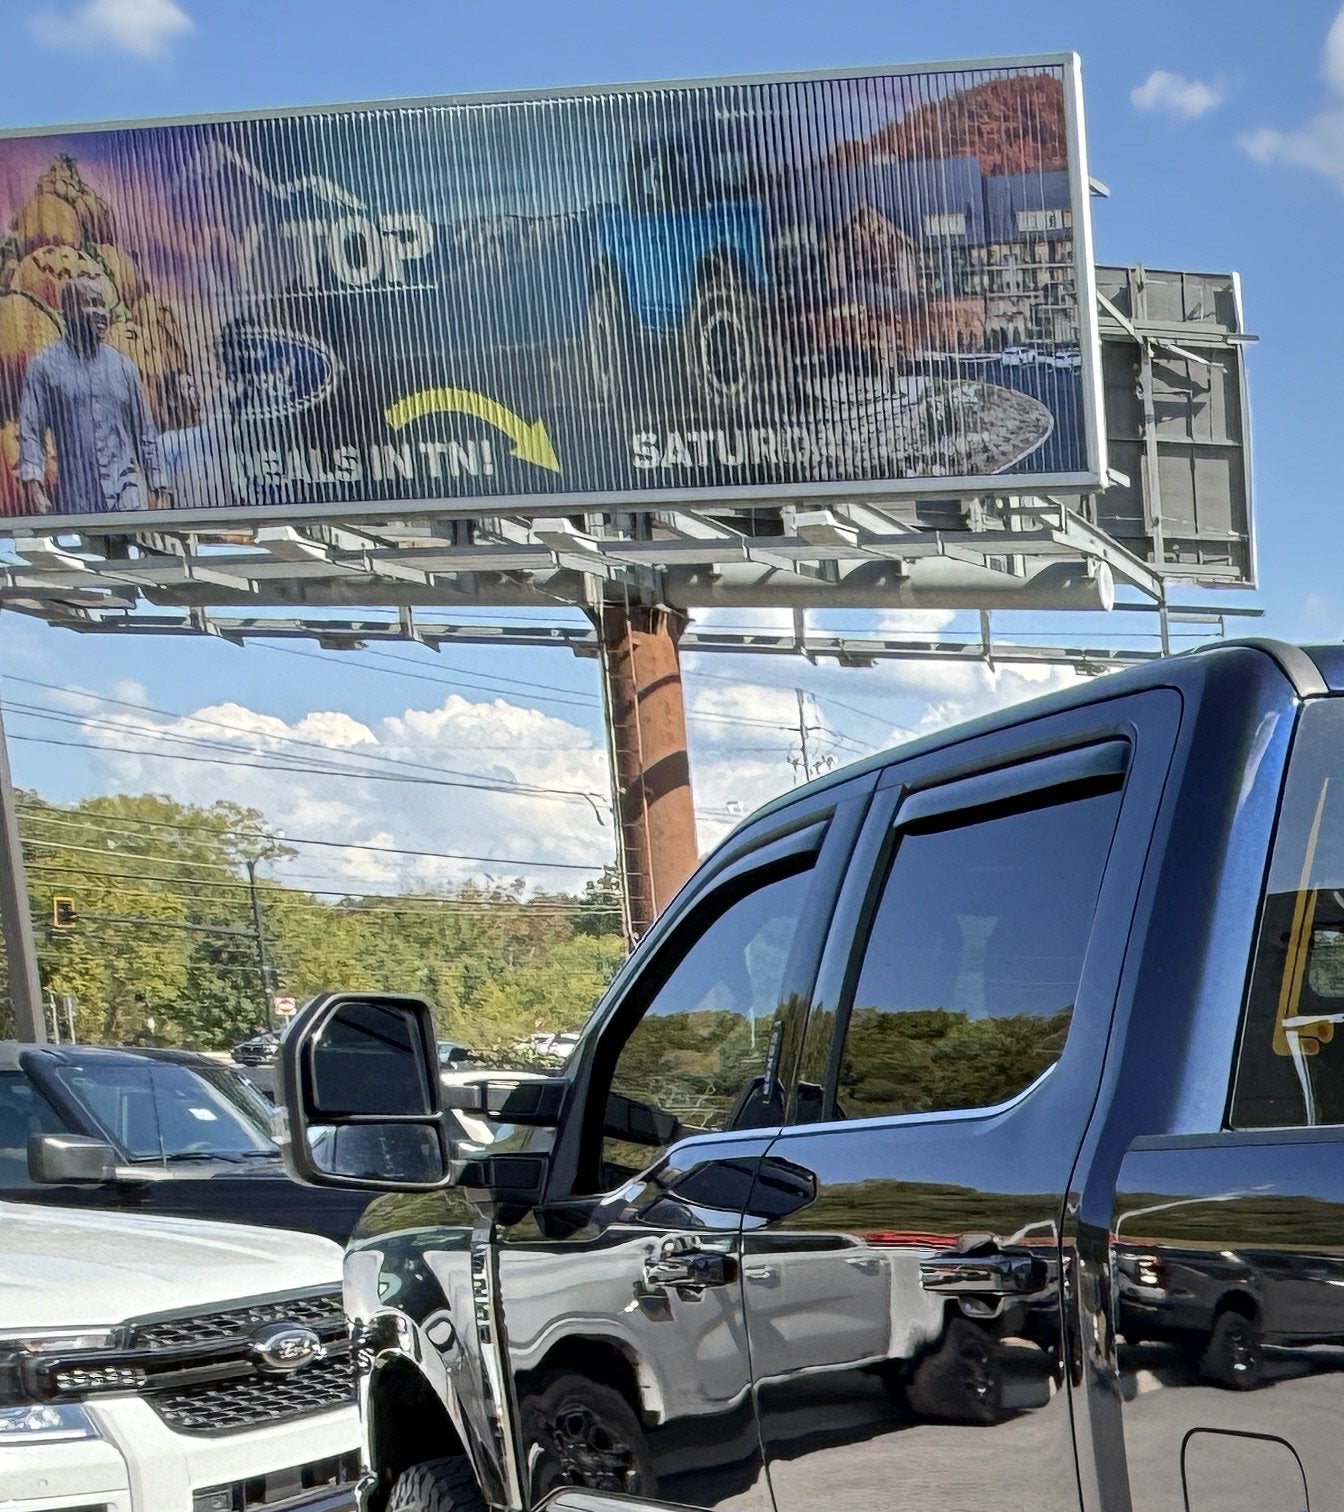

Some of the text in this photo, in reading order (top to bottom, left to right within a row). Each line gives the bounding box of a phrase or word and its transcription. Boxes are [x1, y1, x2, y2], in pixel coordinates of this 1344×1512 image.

[280, 211, 434, 289] TOP
[370, 442, 414, 481] IN
[419, 437, 494, 478] TN!
[632, 428, 812, 469] SATURD
